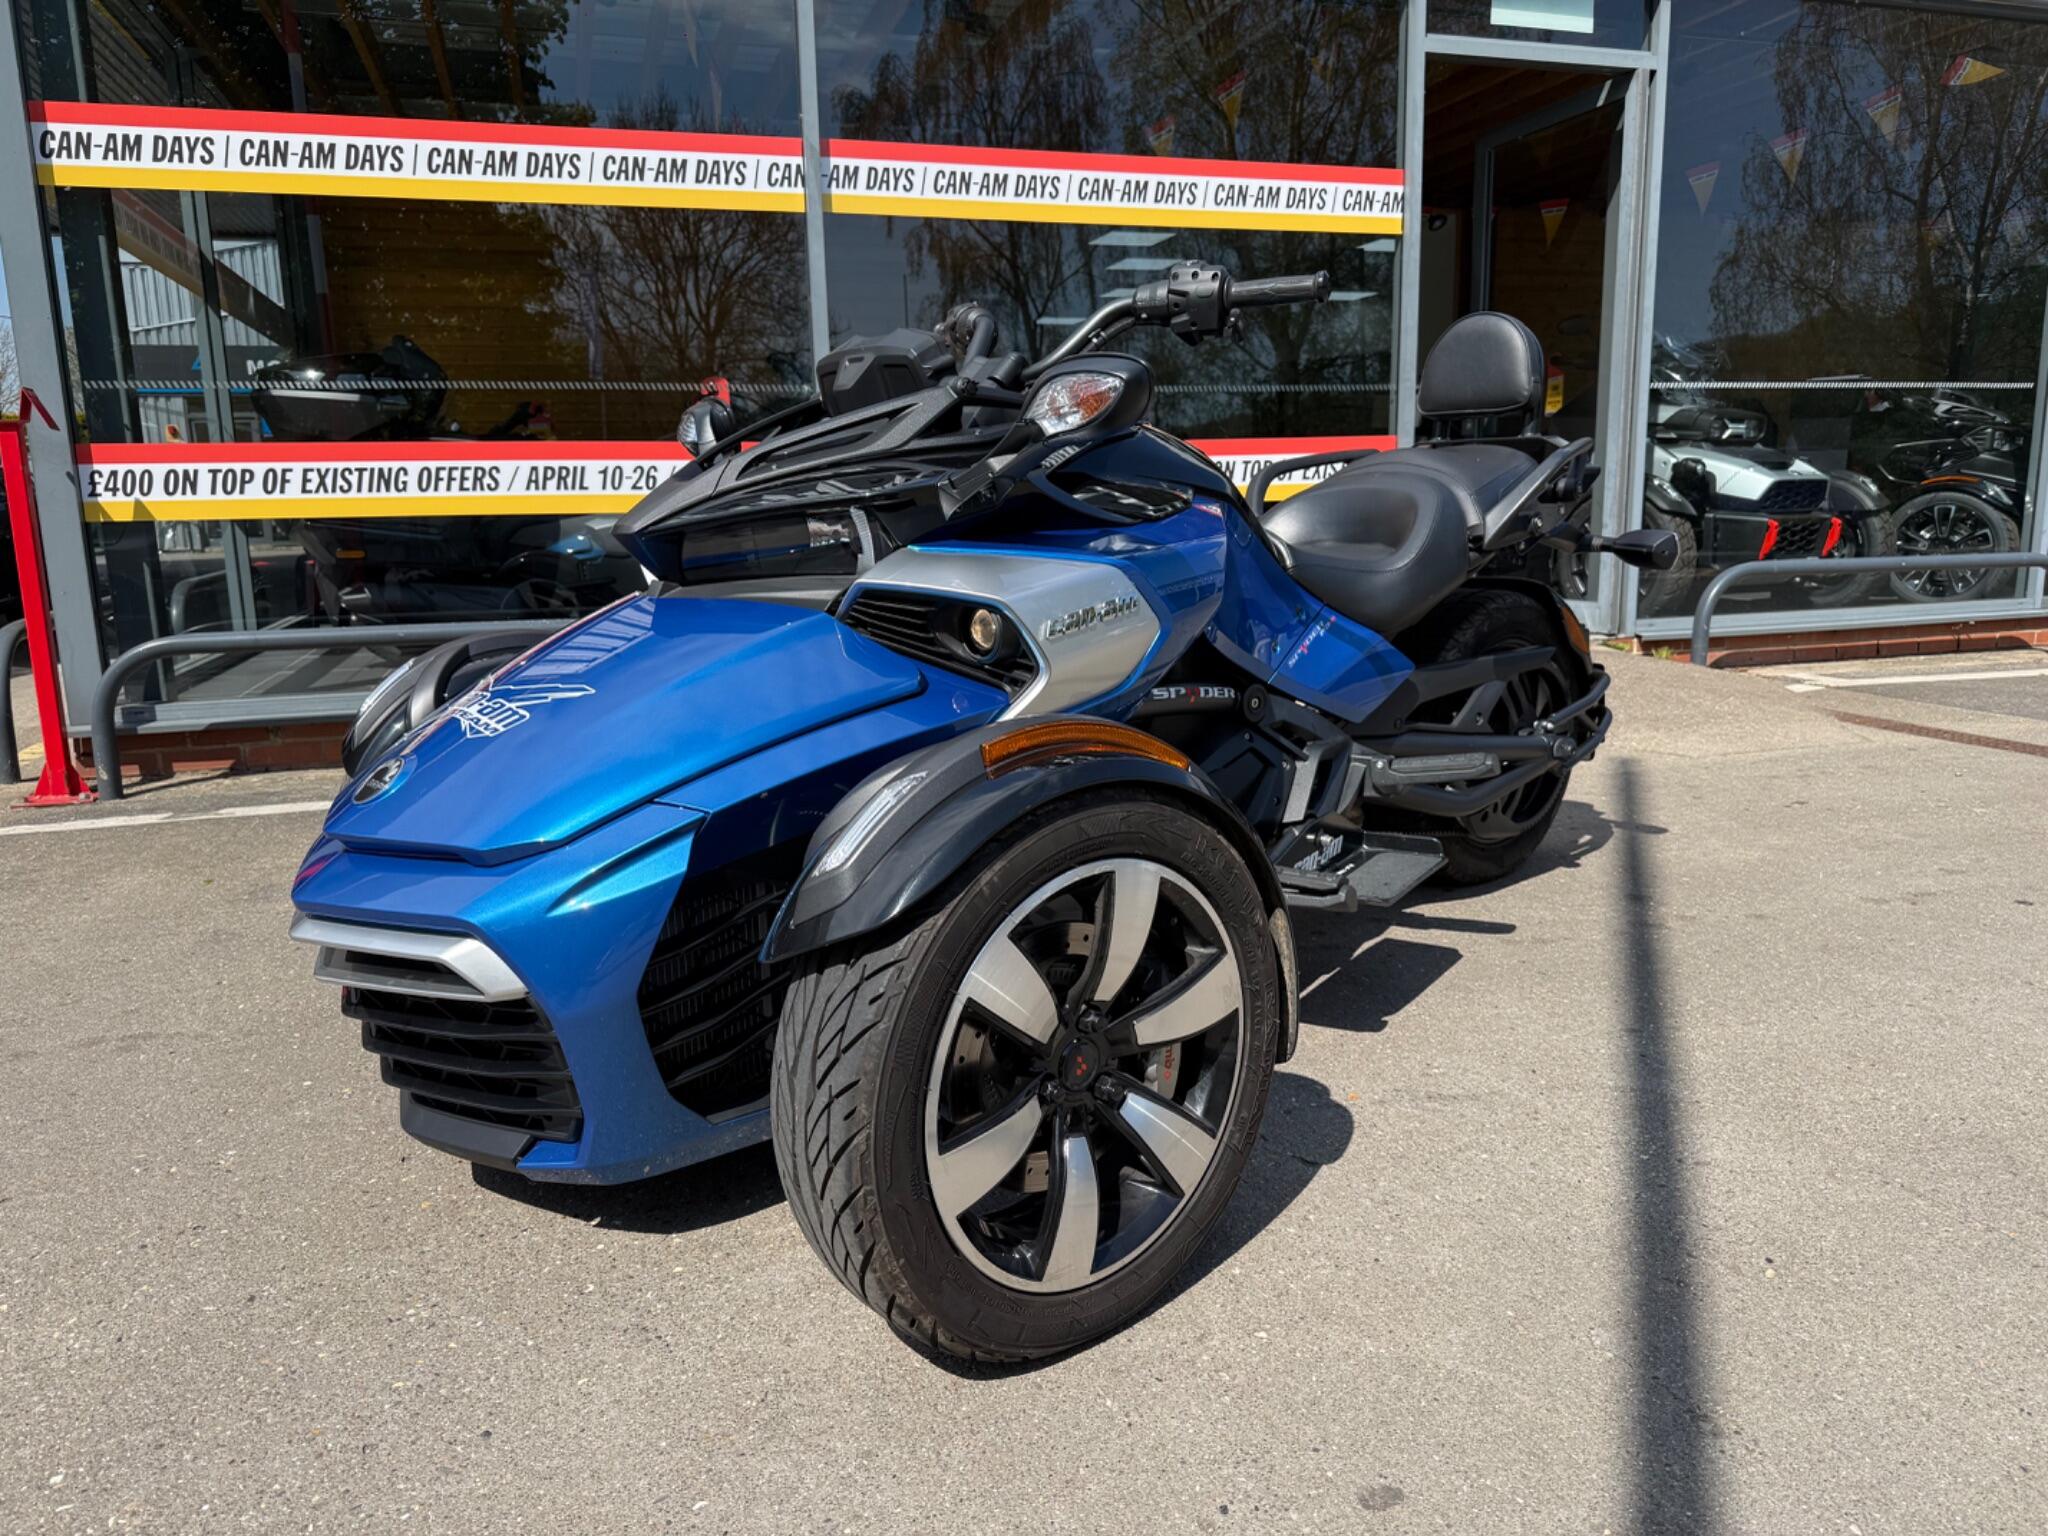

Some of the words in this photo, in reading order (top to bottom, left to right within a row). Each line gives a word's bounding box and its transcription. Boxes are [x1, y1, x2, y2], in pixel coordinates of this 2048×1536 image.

[39, 130, 142, 163] CAN-AM
[152, 135, 215, 166] DAYS
[240, 139, 336, 169] CAN-AM
[345, 144, 403, 172] DAYS
[427, 147, 518, 177] CAN-AM
[526, 152, 581, 180] DAYS
[602, 155, 687, 184] CAN-AM
[695, 159, 747, 186] DAYS
[866, 166, 914, 192] DAYS
[933, 169, 1008, 197] CAN-AM
[1014, 174, 1060, 200] DAYS
[1077, 177, 1148, 203] CAN-AM
[1153, 181, 1198, 205] DAYS
[1214, 184, 1281, 208] CAN-AM
[1286, 187, 1327, 210] DAYS
[1343, 189, 1404, 213] CAN-AM
[87, 469, 153, 497] £400
[163, 469, 199, 496] ON
[208, 468, 254, 496] TOP
[263, 467, 293, 495] OF
[301, 467, 408, 494] EXISTING
[417, 466, 500, 492] OFFERS
[526, 466, 588, 491] APRIL
[598, 465, 658, 491] 10-26
